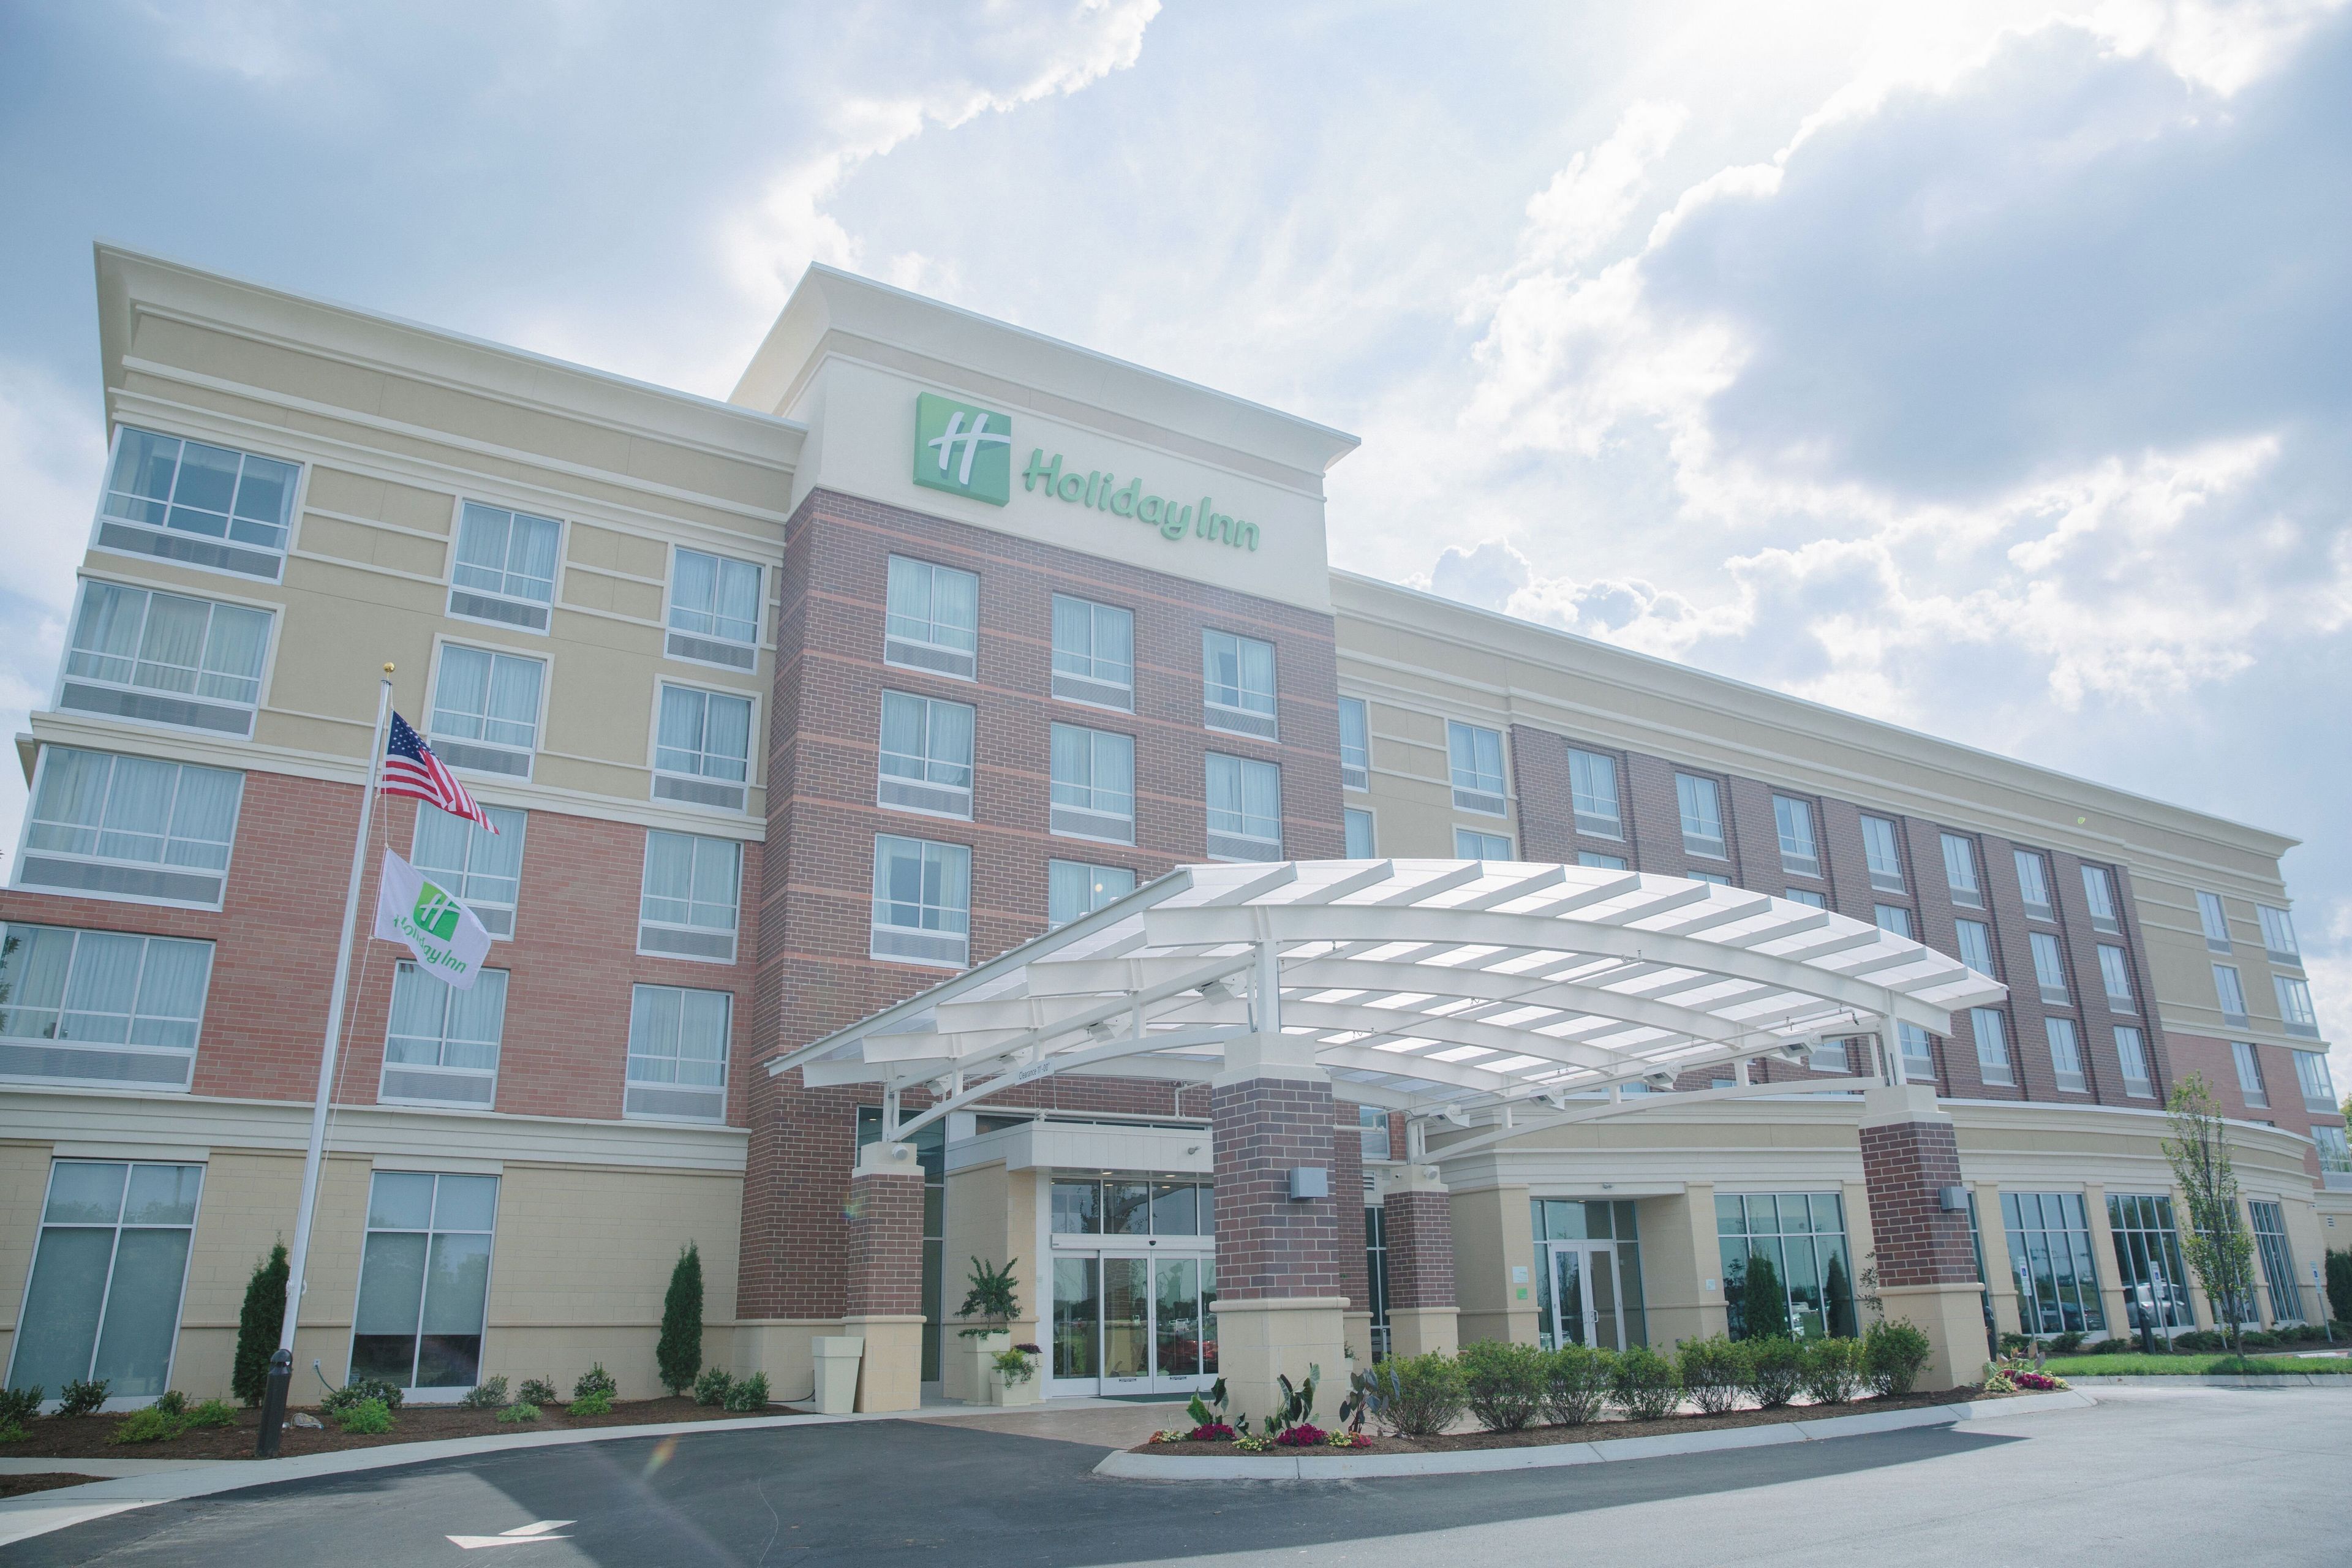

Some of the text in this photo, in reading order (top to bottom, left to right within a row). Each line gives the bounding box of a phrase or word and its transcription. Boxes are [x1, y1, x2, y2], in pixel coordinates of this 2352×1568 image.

[1022, 448, 1260, 551] Holiday Inn
[393, 914, 467, 973] Holiday Inn
[1019, 1068, 1036, 1079] Clearance
